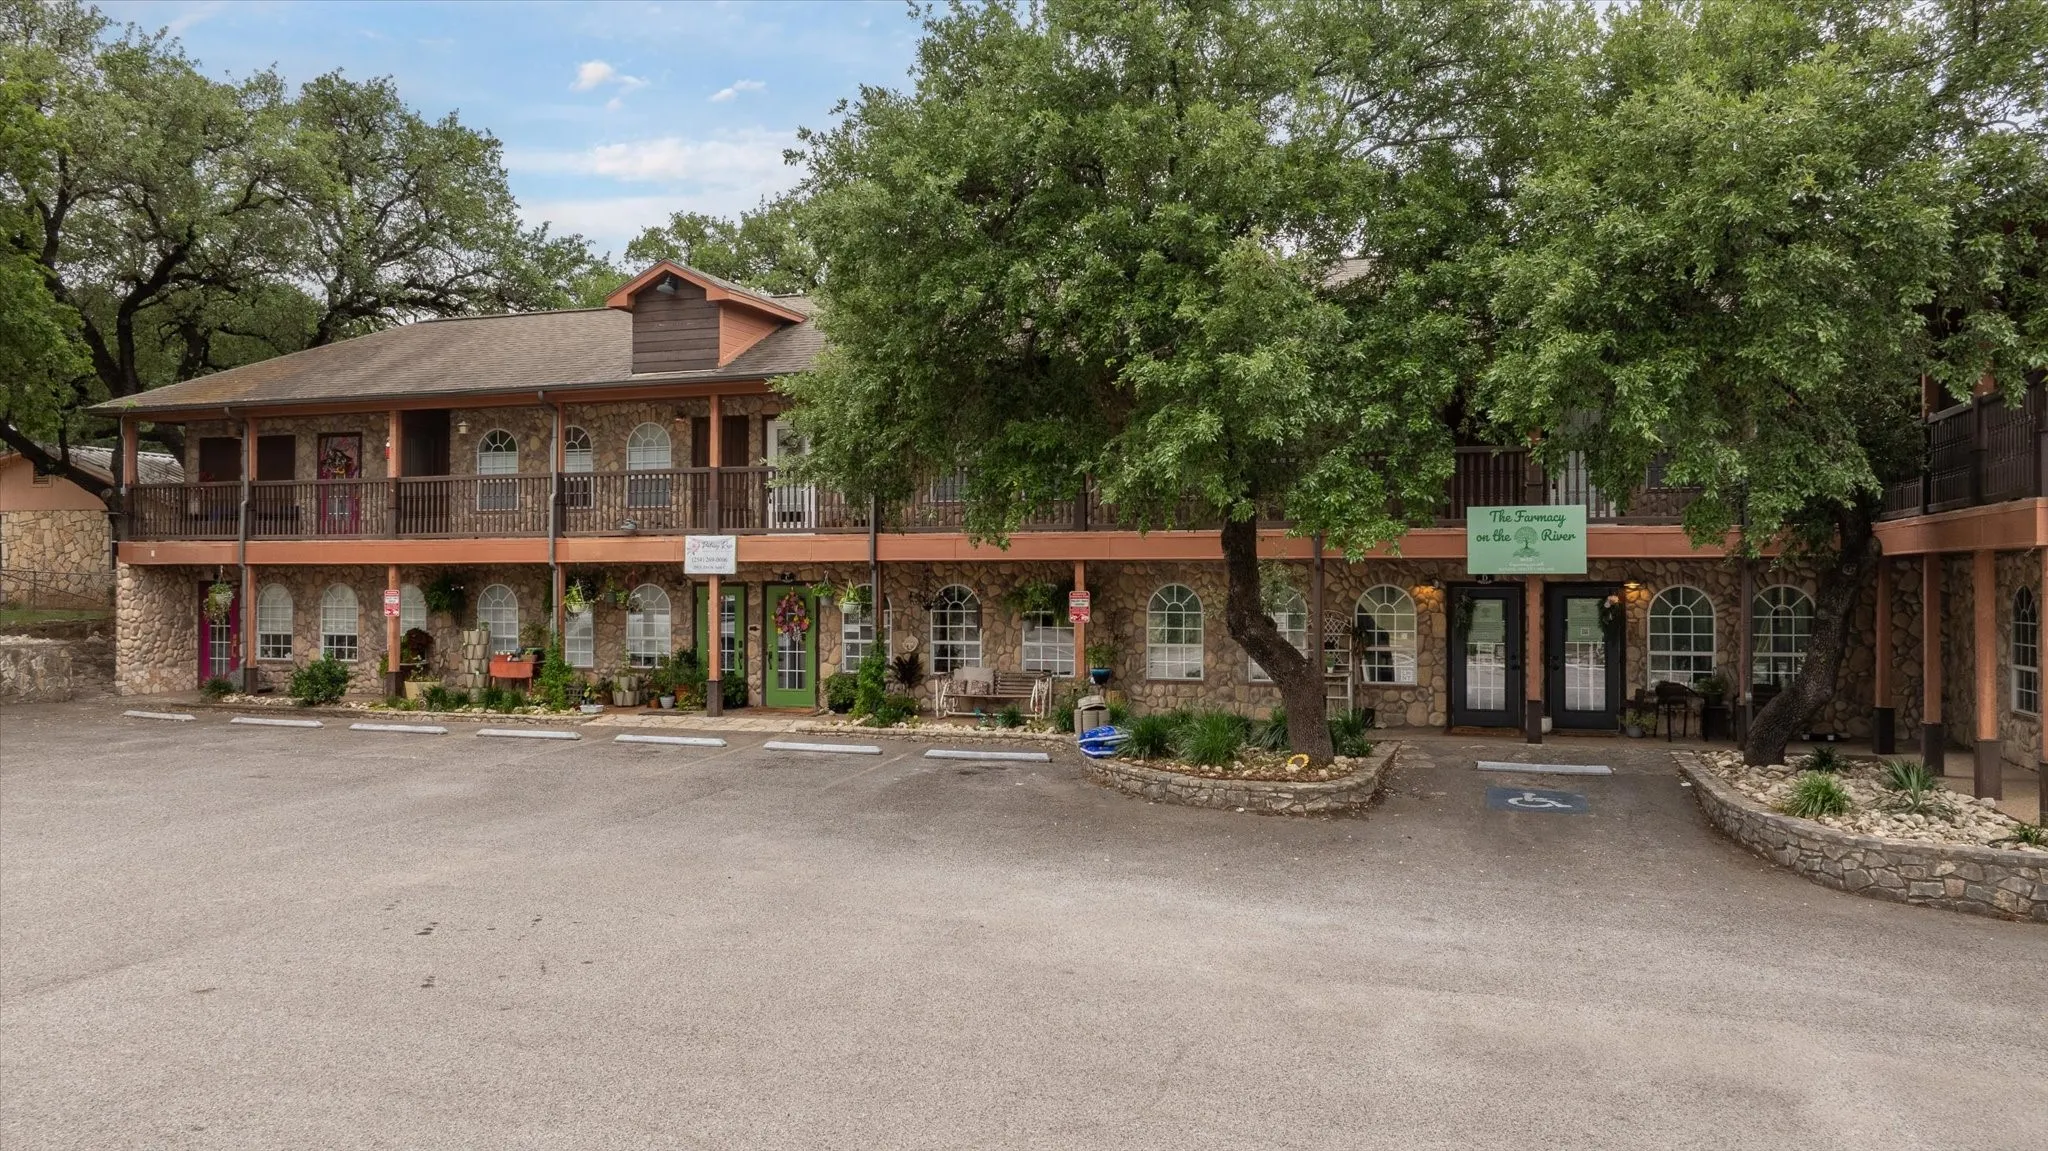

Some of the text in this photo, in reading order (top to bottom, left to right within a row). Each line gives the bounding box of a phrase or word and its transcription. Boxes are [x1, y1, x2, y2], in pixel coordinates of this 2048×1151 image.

[1489, 509, 1566, 527] The Farmacy
[1476, 529, 1576, 542] on the River
